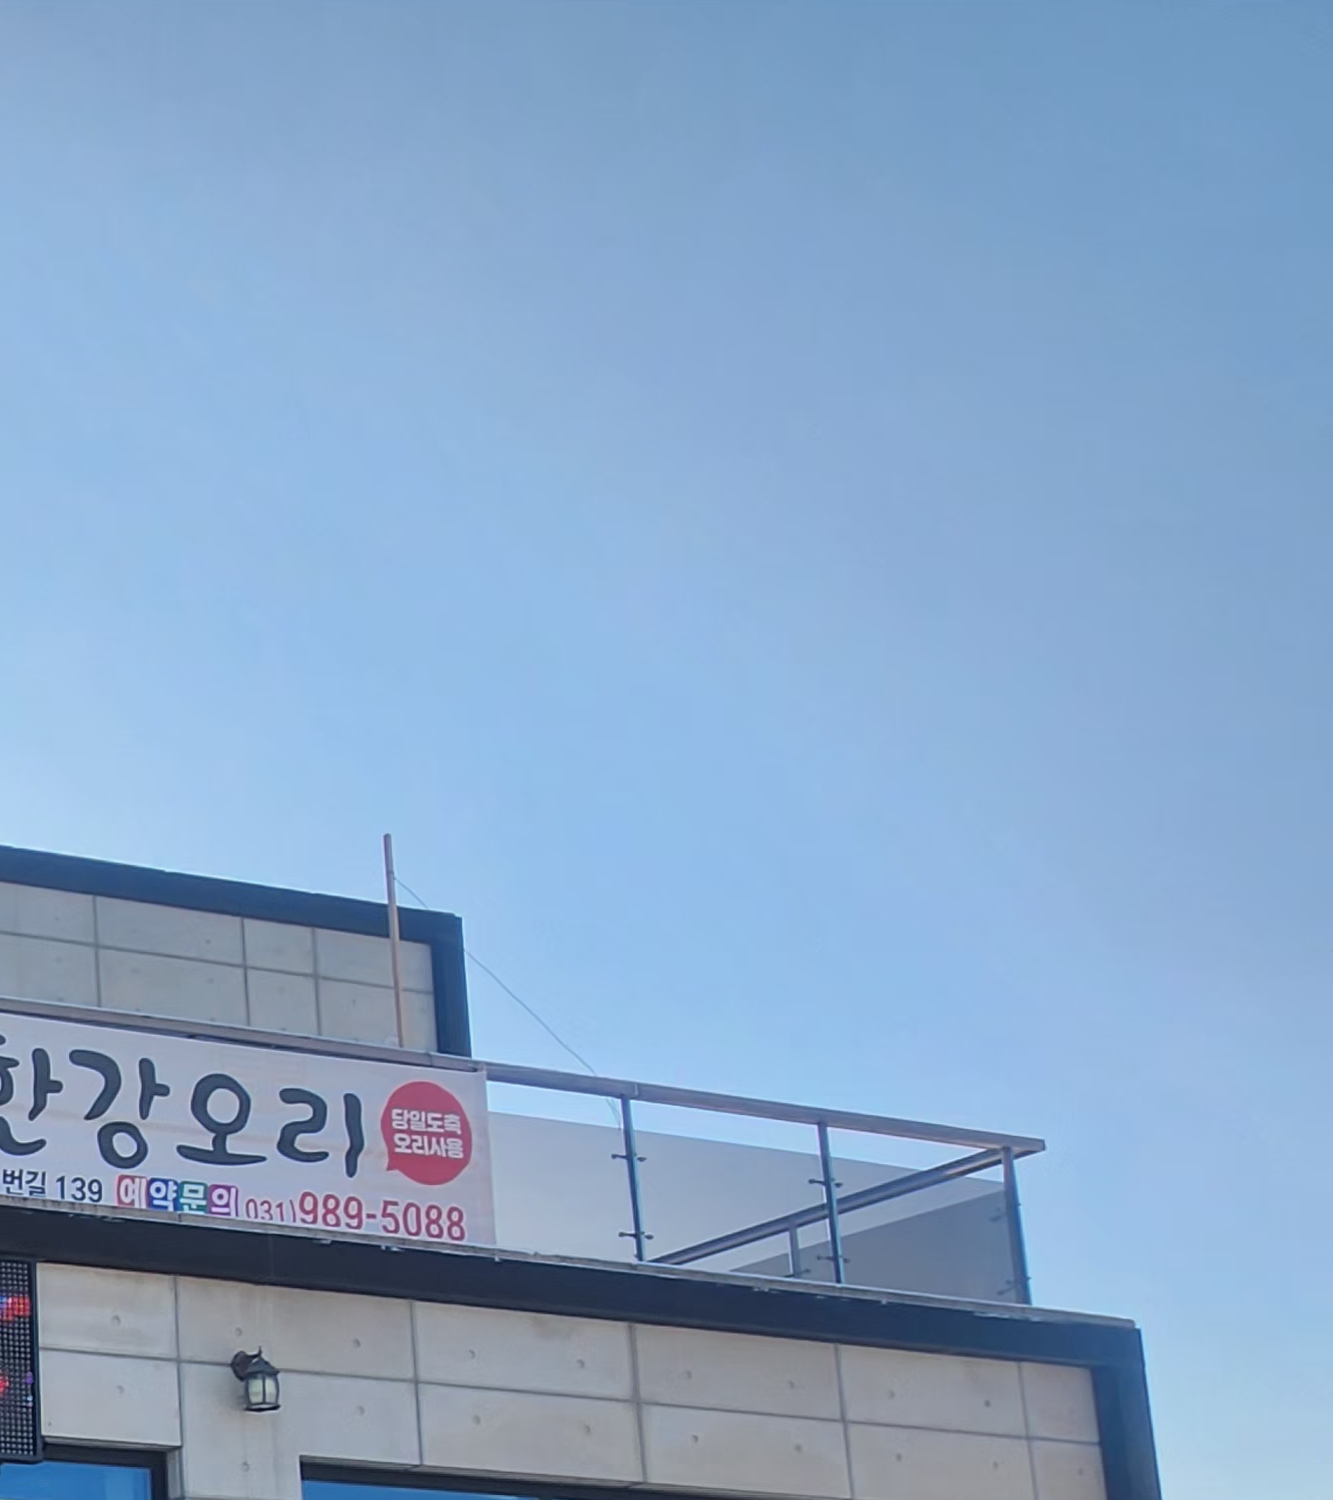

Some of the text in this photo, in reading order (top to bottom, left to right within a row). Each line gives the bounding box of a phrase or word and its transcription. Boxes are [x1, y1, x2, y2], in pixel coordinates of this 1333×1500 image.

[391, 1107, 462, 1135] 당일도축
[393, 1132, 465, 1159] 오리사용
[55, 1175, 103, 1204] 139
[118, 1175, 239, 1217] 예약문의
